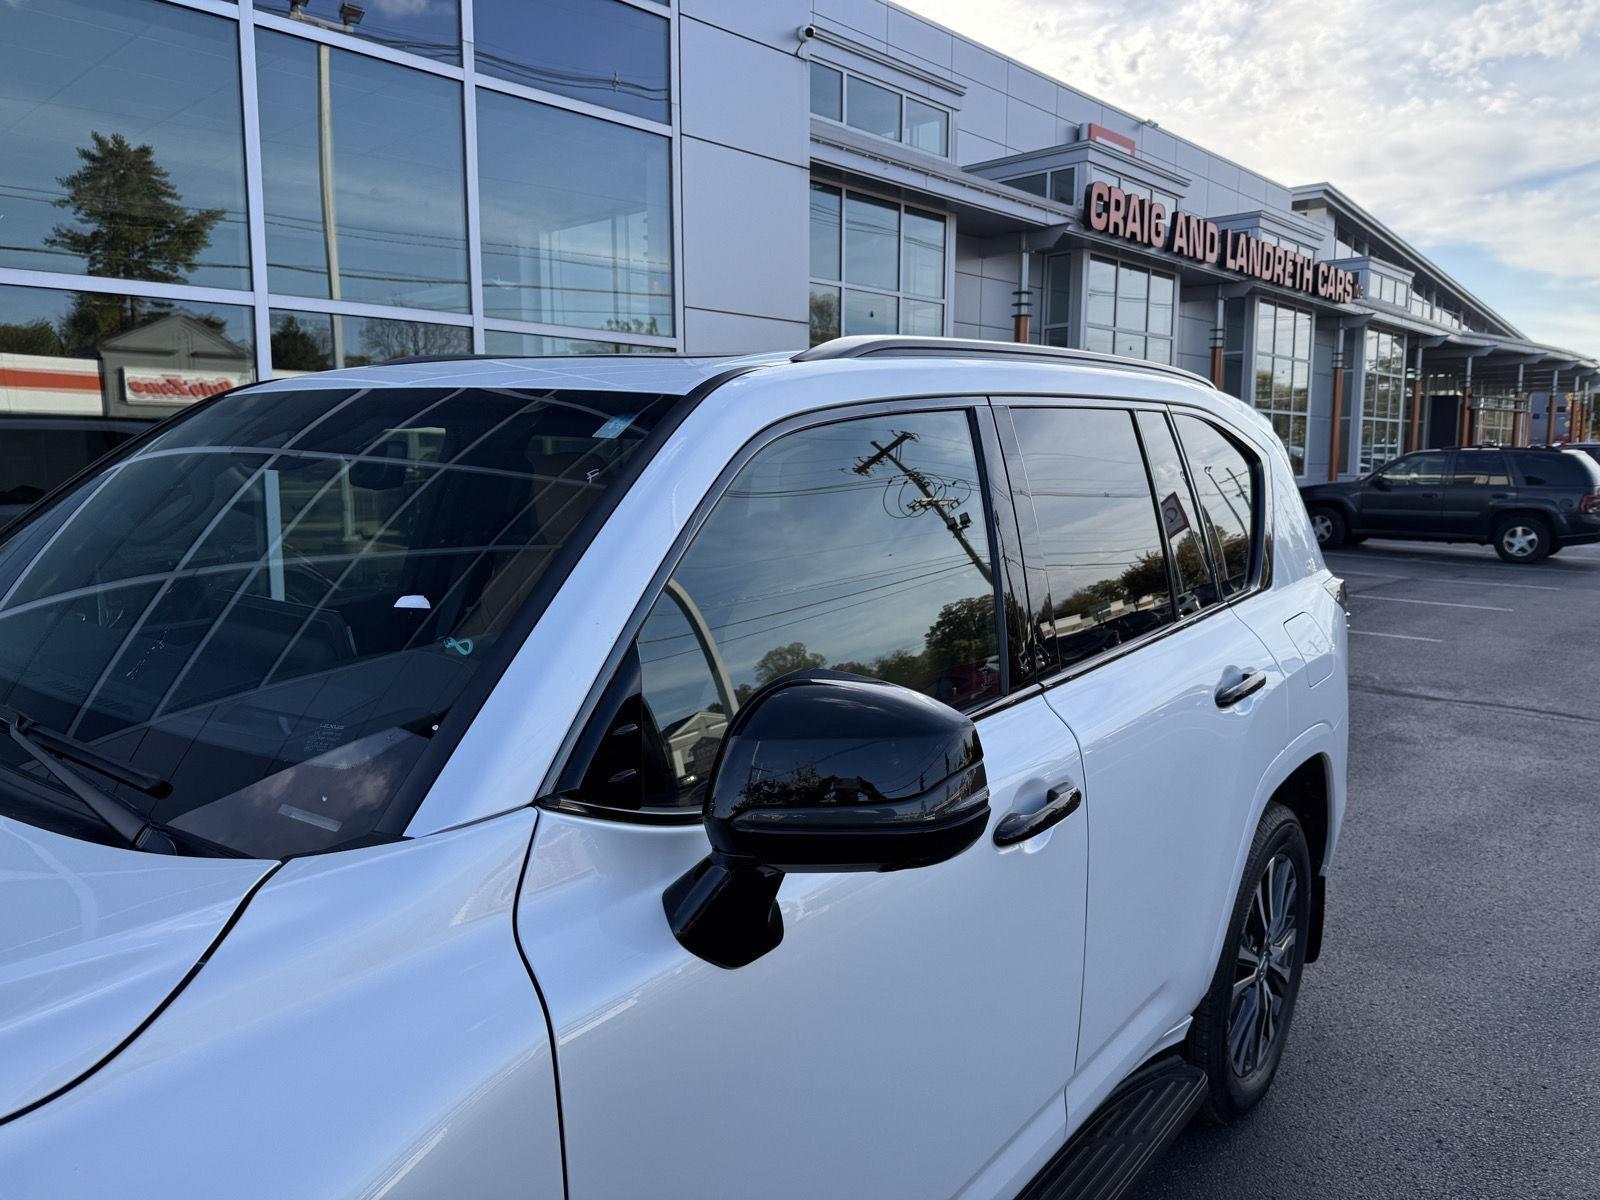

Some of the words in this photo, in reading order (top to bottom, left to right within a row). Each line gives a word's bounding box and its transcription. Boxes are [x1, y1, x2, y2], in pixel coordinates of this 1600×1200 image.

[1087, 181, 1166, 248] CRAIG
[1171, 211, 1219, 264] AND
[1225, 229, 1313, 293] LANDRETH
[1317, 262, 1354, 304] CARS
